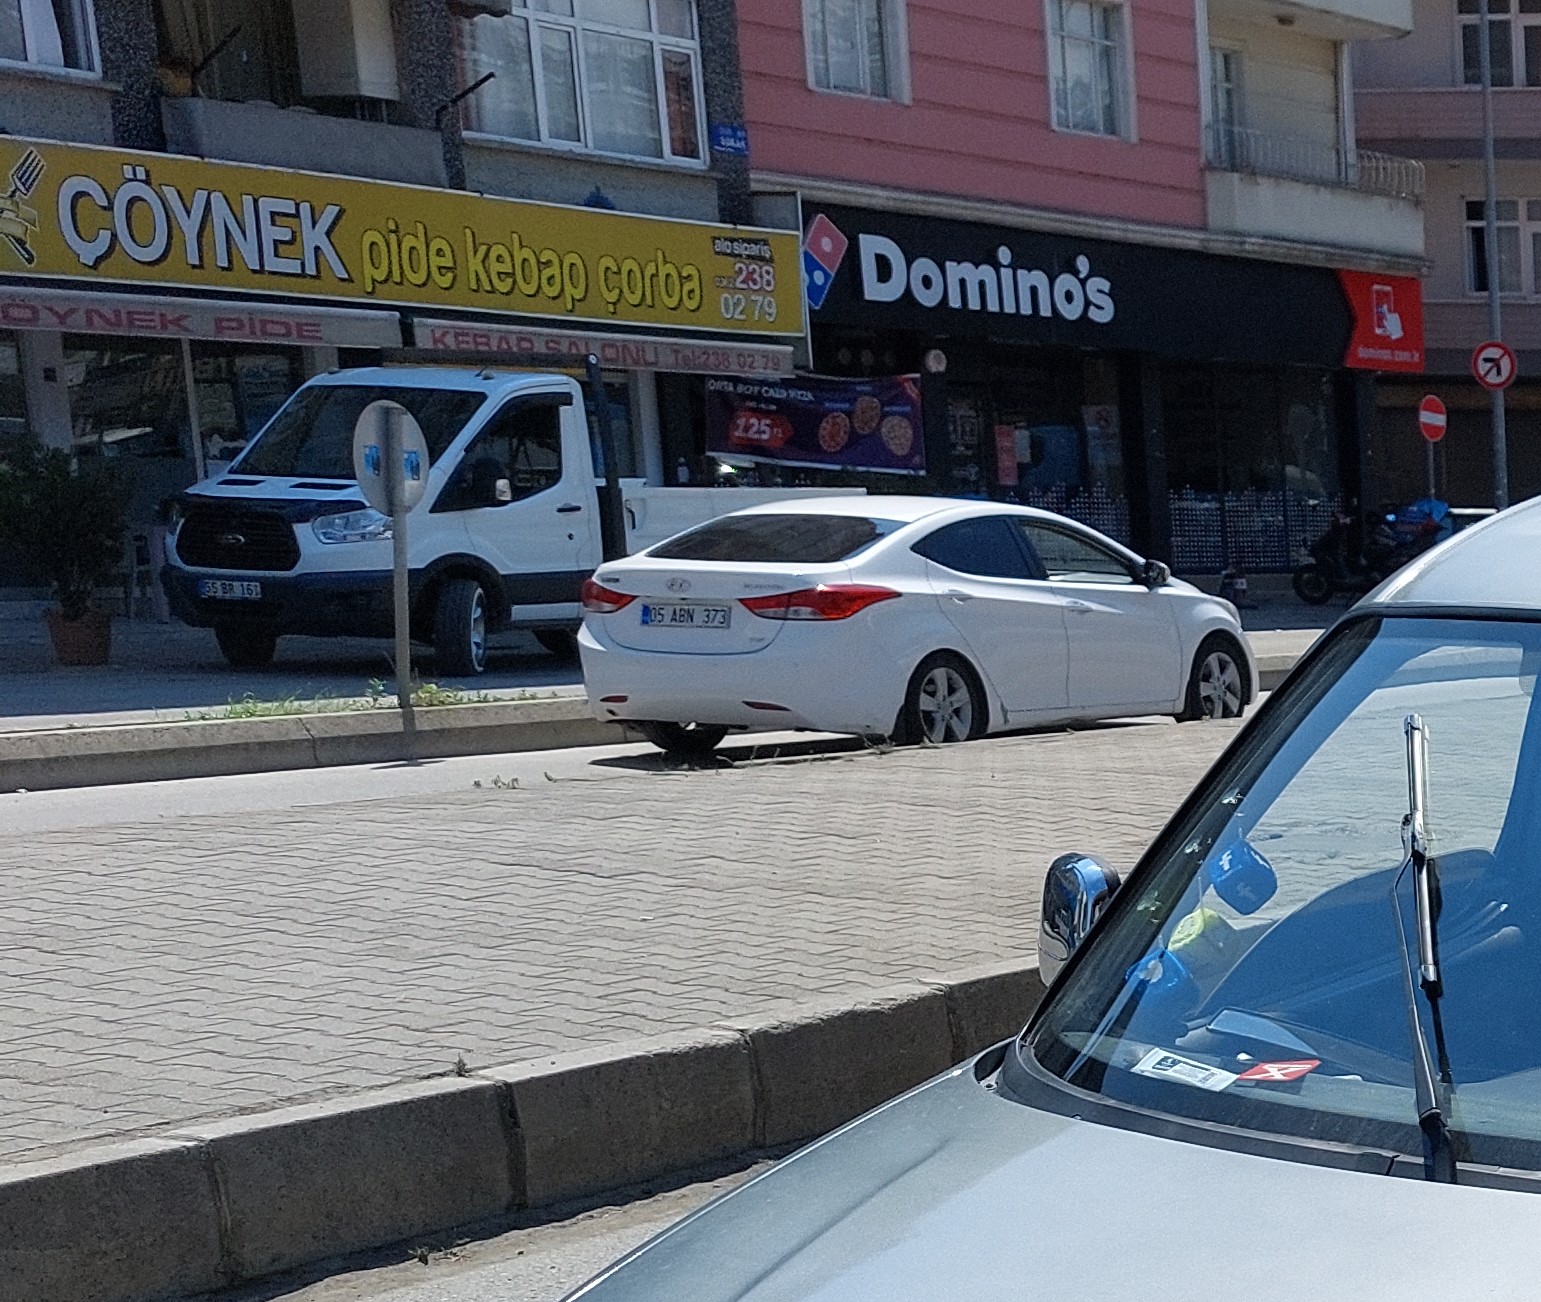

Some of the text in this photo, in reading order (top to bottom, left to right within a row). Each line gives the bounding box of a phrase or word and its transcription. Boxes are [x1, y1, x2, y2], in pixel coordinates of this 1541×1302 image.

[57, 163, 702, 315] ÇÖYNEK pide kebap çorba
[734, 263, 775, 292] 238
[858, 233, 1116, 324] Domino's
[720, 293, 777, 323] 02 79
[736, 352, 757, 370] 02
[735, 417, 771, 440] 125
[650, 607, 727, 625] 05 ABN 373
